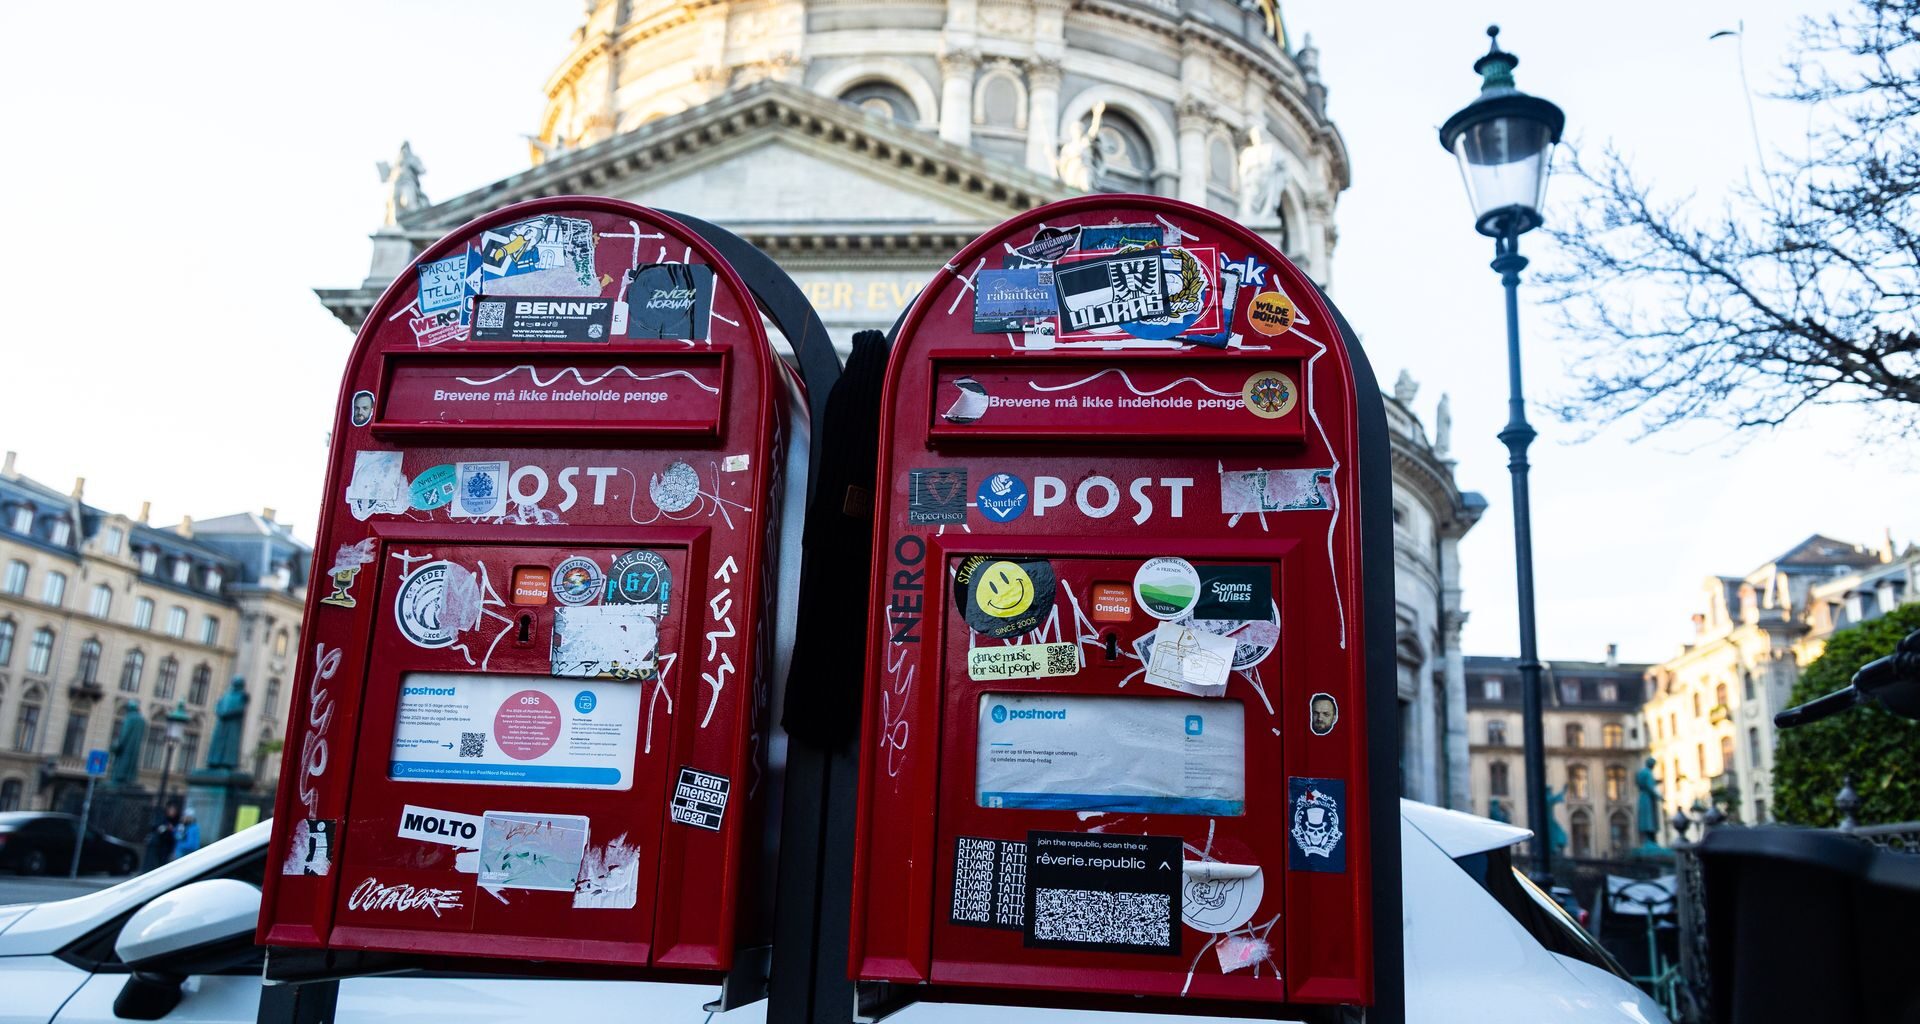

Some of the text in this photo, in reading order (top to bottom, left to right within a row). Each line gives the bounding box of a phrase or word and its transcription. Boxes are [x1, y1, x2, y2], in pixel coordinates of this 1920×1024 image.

[420, 258, 466, 277] PAROLE
[986, 289, 1049, 301] rabauken
[646, 298, 696, 310] NORWAY
[1068, 293, 1164, 328] ULTRAS
[1255, 301, 1289, 317] WILDE
[434, 388, 668, 404] Brevene må ikke indeholde penge
[989, 394, 1246, 411] Brevene må ikke indeholde penge
[508, 465, 618, 512] OST
[1032, 476, 1194, 525] POST
[910, 511, 963, 522] Pepecrusco
[614, 551, 668, 573] THE GREAT
[957, 555, 993, 585] STAMM
[415, 570, 446, 586] VEDET
[624, 571, 656, 593] 67
[515, 588, 549, 598] Onsdag
[890, 534, 926, 643] NERO
[1095, 603, 1131, 615] Onsdag
[995, 616, 1037, 636] SINCE 2005
[972, 648, 1032, 664] dance music
[972, 661, 1041, 677] for sad people
[403, 686, 456, 697] postnord
[520, 696, 540, 705] OBS
[1009, 708, 1067, 721] postnord
[693, 773, 722, 791] kein
[678, 785, 725, 805] mensch
[686, 800, 699, 810] ist
[675, 807, 707, 825] illegal
[403, 813, 477, 840] MOLTO
[959, 838, 996, 851] RIXARD
[1037, 838, 1052, 847] join
[1053, 838, 1067, 847] the
[1067, 839, 1102, 849] republic,
[1123, 842, 1138, 850] the
[1138, 843, 1149, 851] qr.
[958, 848, 995, 861] RIXARD
[1036, 852, 1146, 870] rêverie.republic
[957, 858, 994, 871] RIXARD
[956, 868, 993, 881] RIXARD
[955, 878, 992, 891] RIXARD
[954, 889, 992, 901] RIXARD
[953, 899, 991, 912] RIXARD
[952, 909, 990, 922] RIXARD
